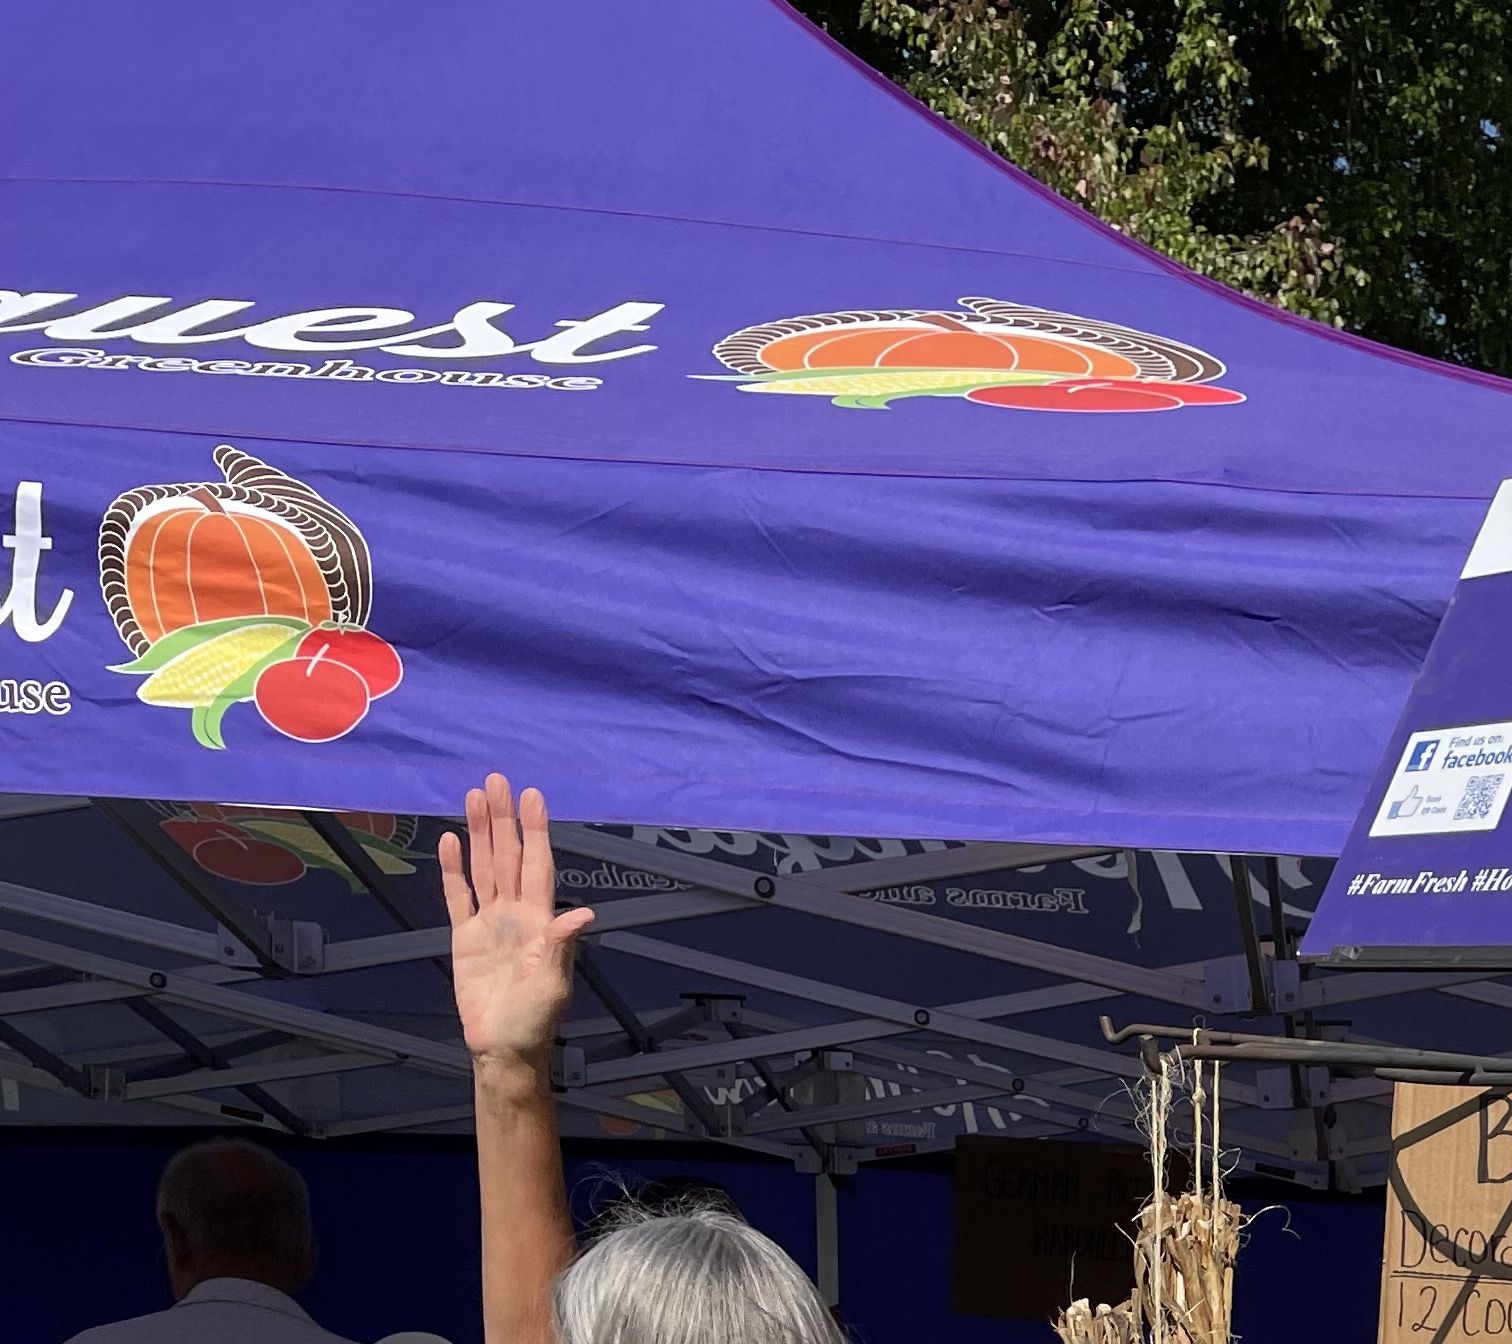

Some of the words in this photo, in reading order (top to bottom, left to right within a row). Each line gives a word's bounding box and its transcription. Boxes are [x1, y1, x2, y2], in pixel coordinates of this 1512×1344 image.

[9, 347, 605, 391] Greenhouse
[1448, 735, 1471, 748] Find
[1474, 737, 1487, 746] us
[1347, 869, 1469, 896] #FarmFresh
[1398, 1282, 1438, 1333] 12
